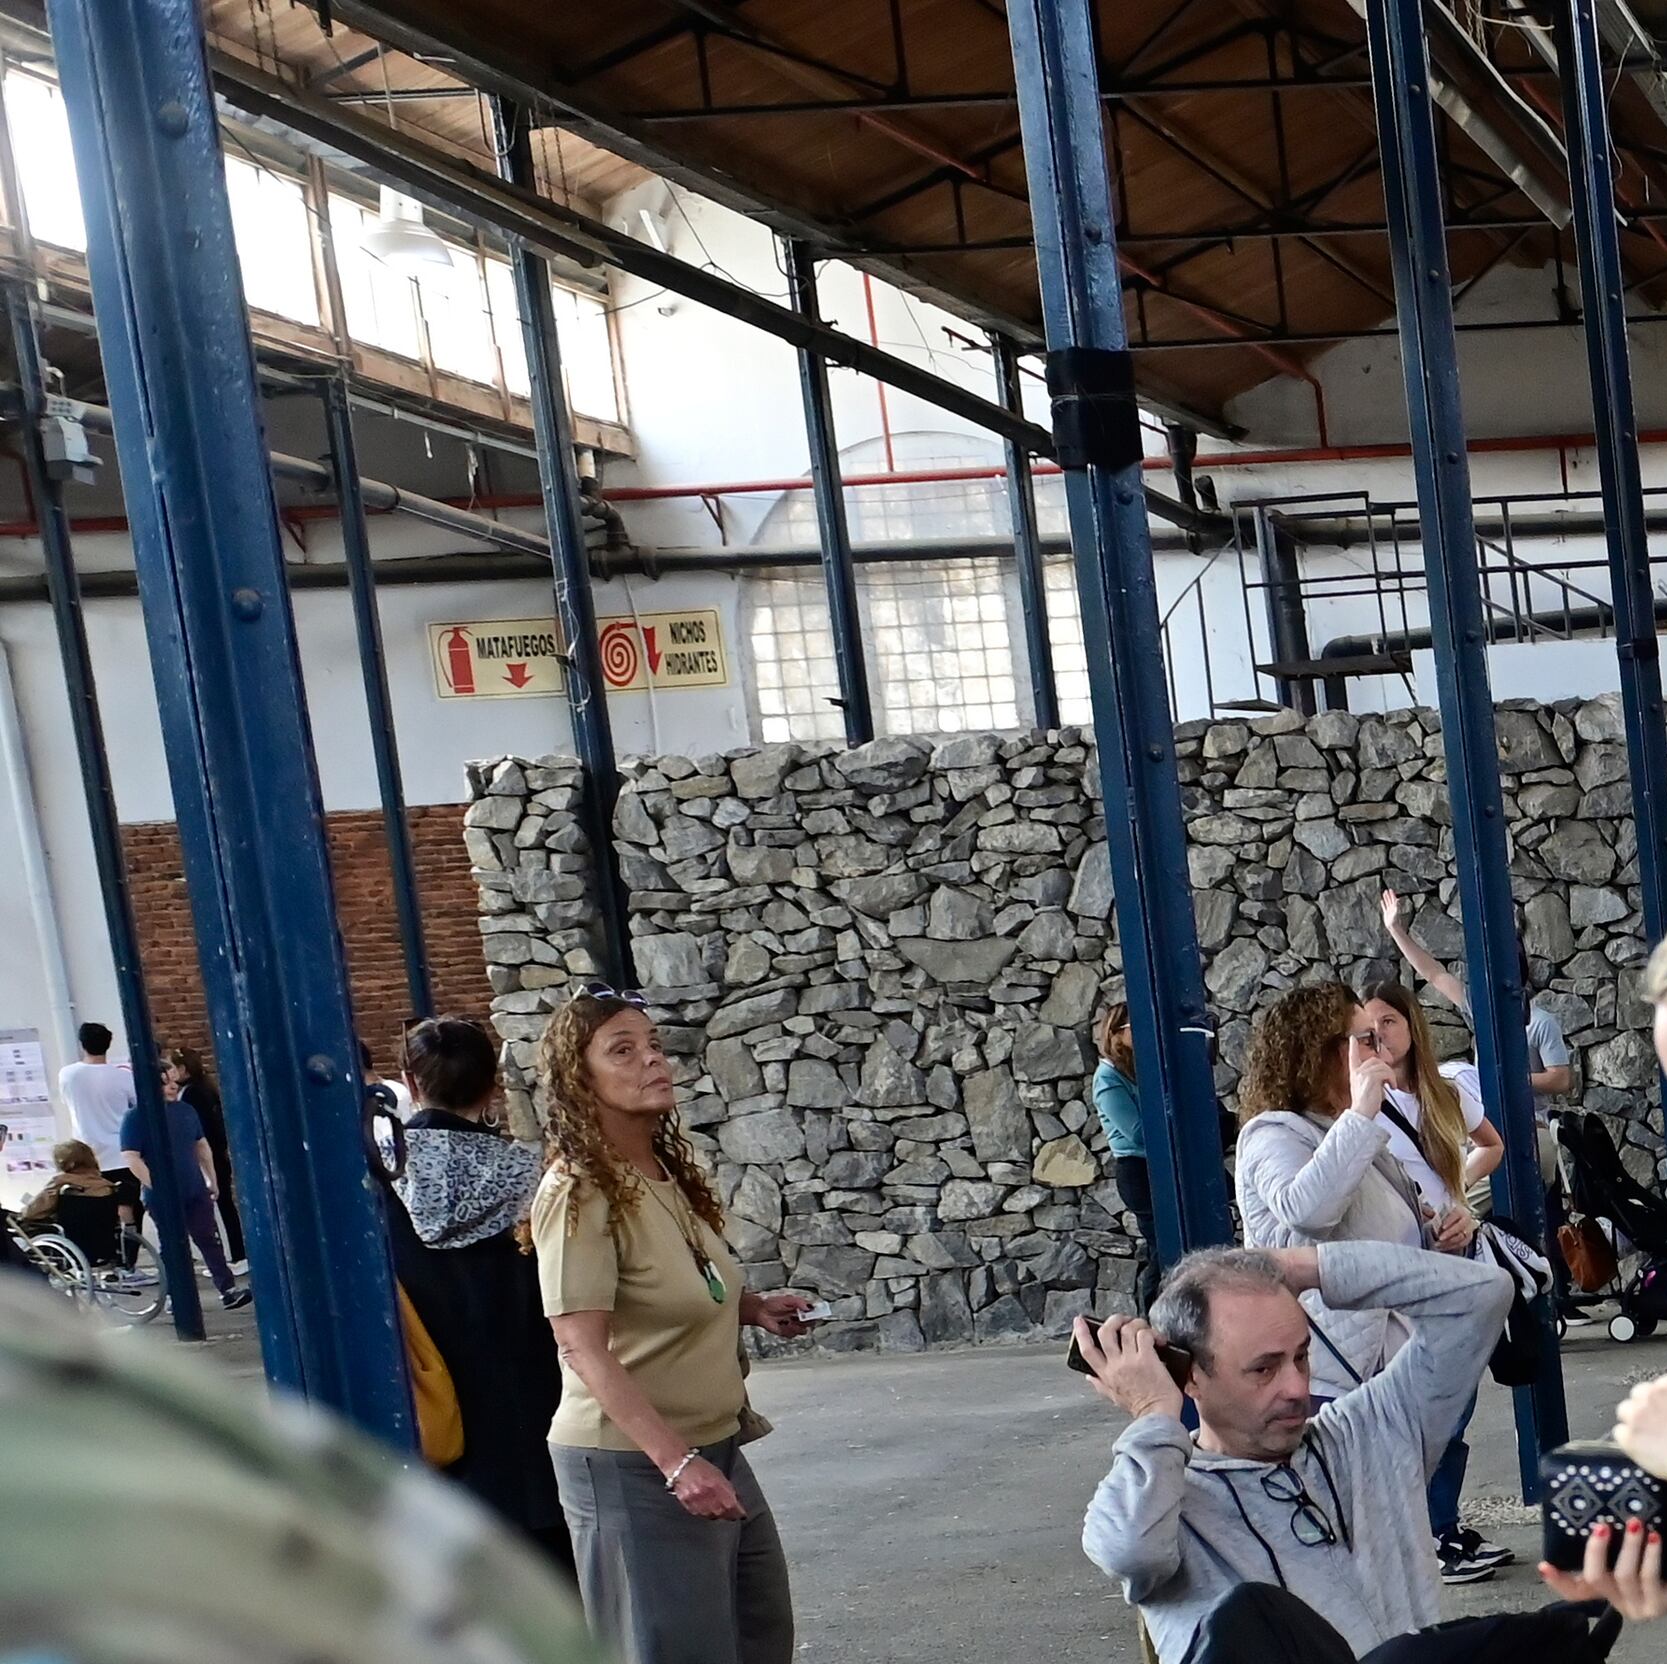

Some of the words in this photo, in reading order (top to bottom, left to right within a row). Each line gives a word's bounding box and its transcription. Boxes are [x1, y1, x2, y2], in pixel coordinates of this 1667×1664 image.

[669, 620, 706, 644] NICHOS
[476, 634, 555, 659] MATAFUEGOS
[664, 650, 718, 675] HIDRANTES
